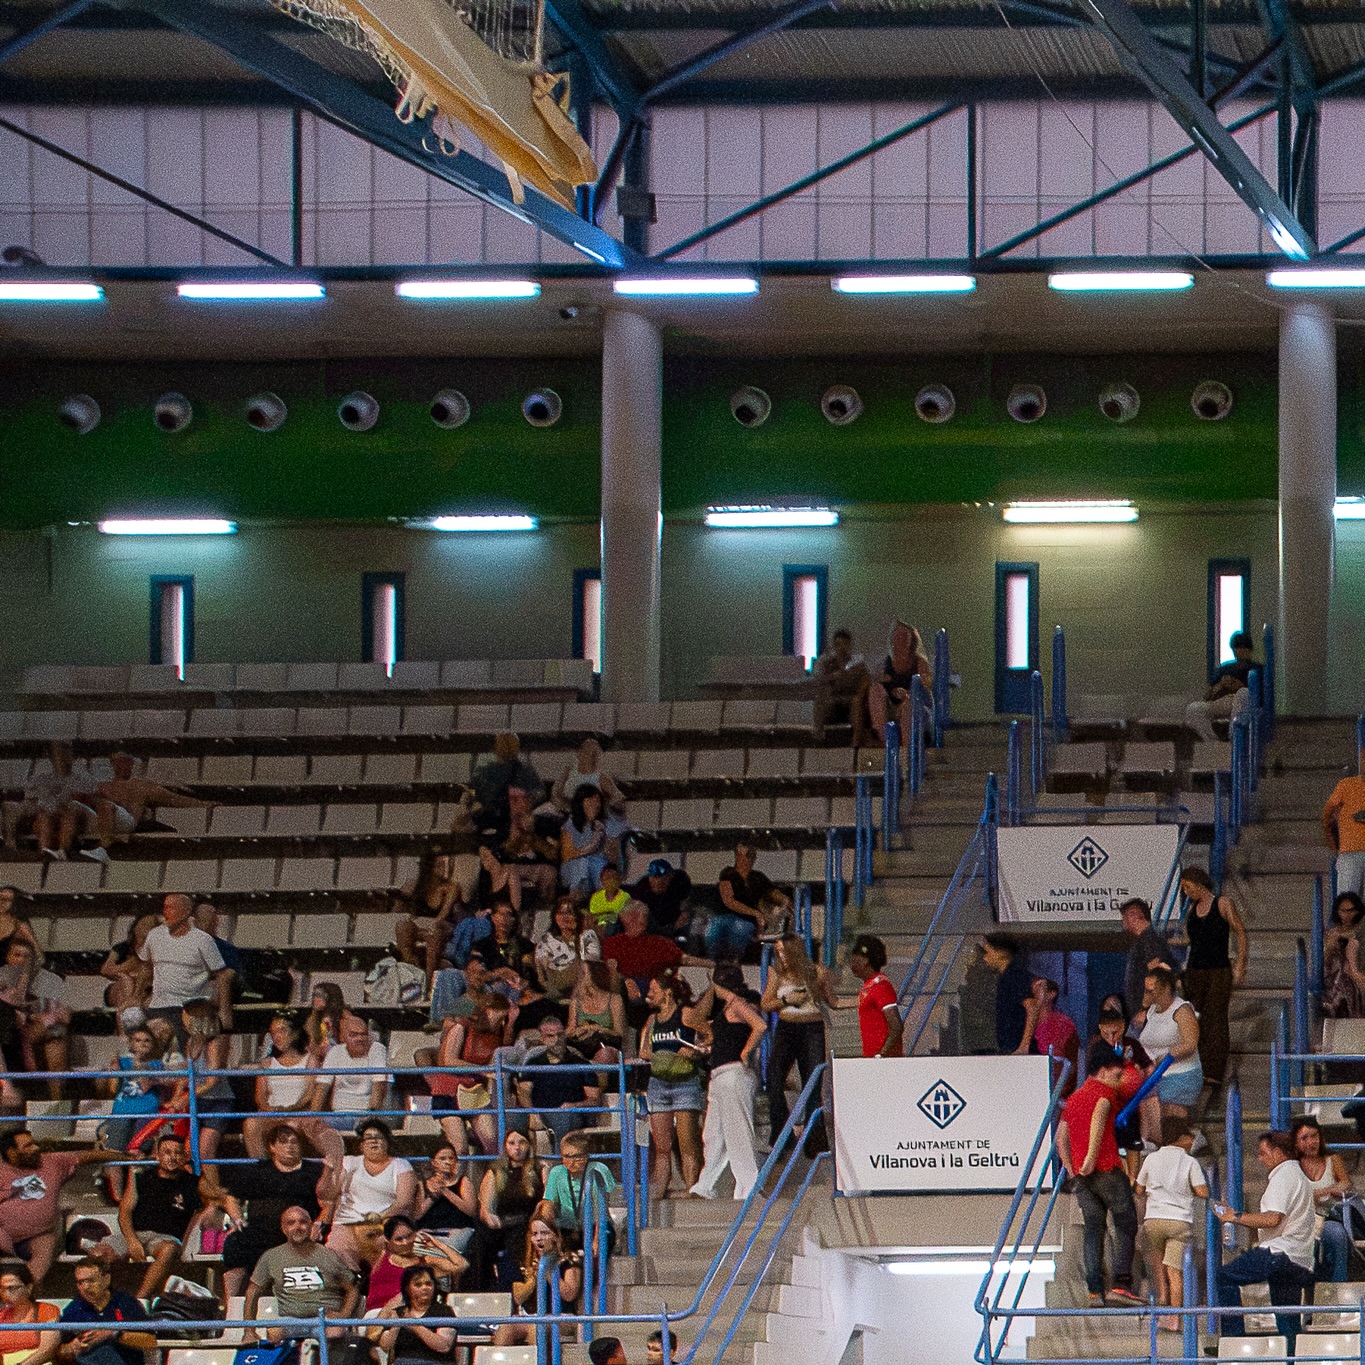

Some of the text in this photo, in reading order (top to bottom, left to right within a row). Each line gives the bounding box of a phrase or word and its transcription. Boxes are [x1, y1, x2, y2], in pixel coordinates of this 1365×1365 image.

[1026, 899, 1084, 912] Vilanova
[1095, 898, 1106, 911] la
[897, 1140, 990, 1150] AJUNTAMENT DE
[869, 1154, 937, 1169] Vilanova
[949, 1153, 963, 1168] la
[968, 1152, 1019, 1168] Geltrú
